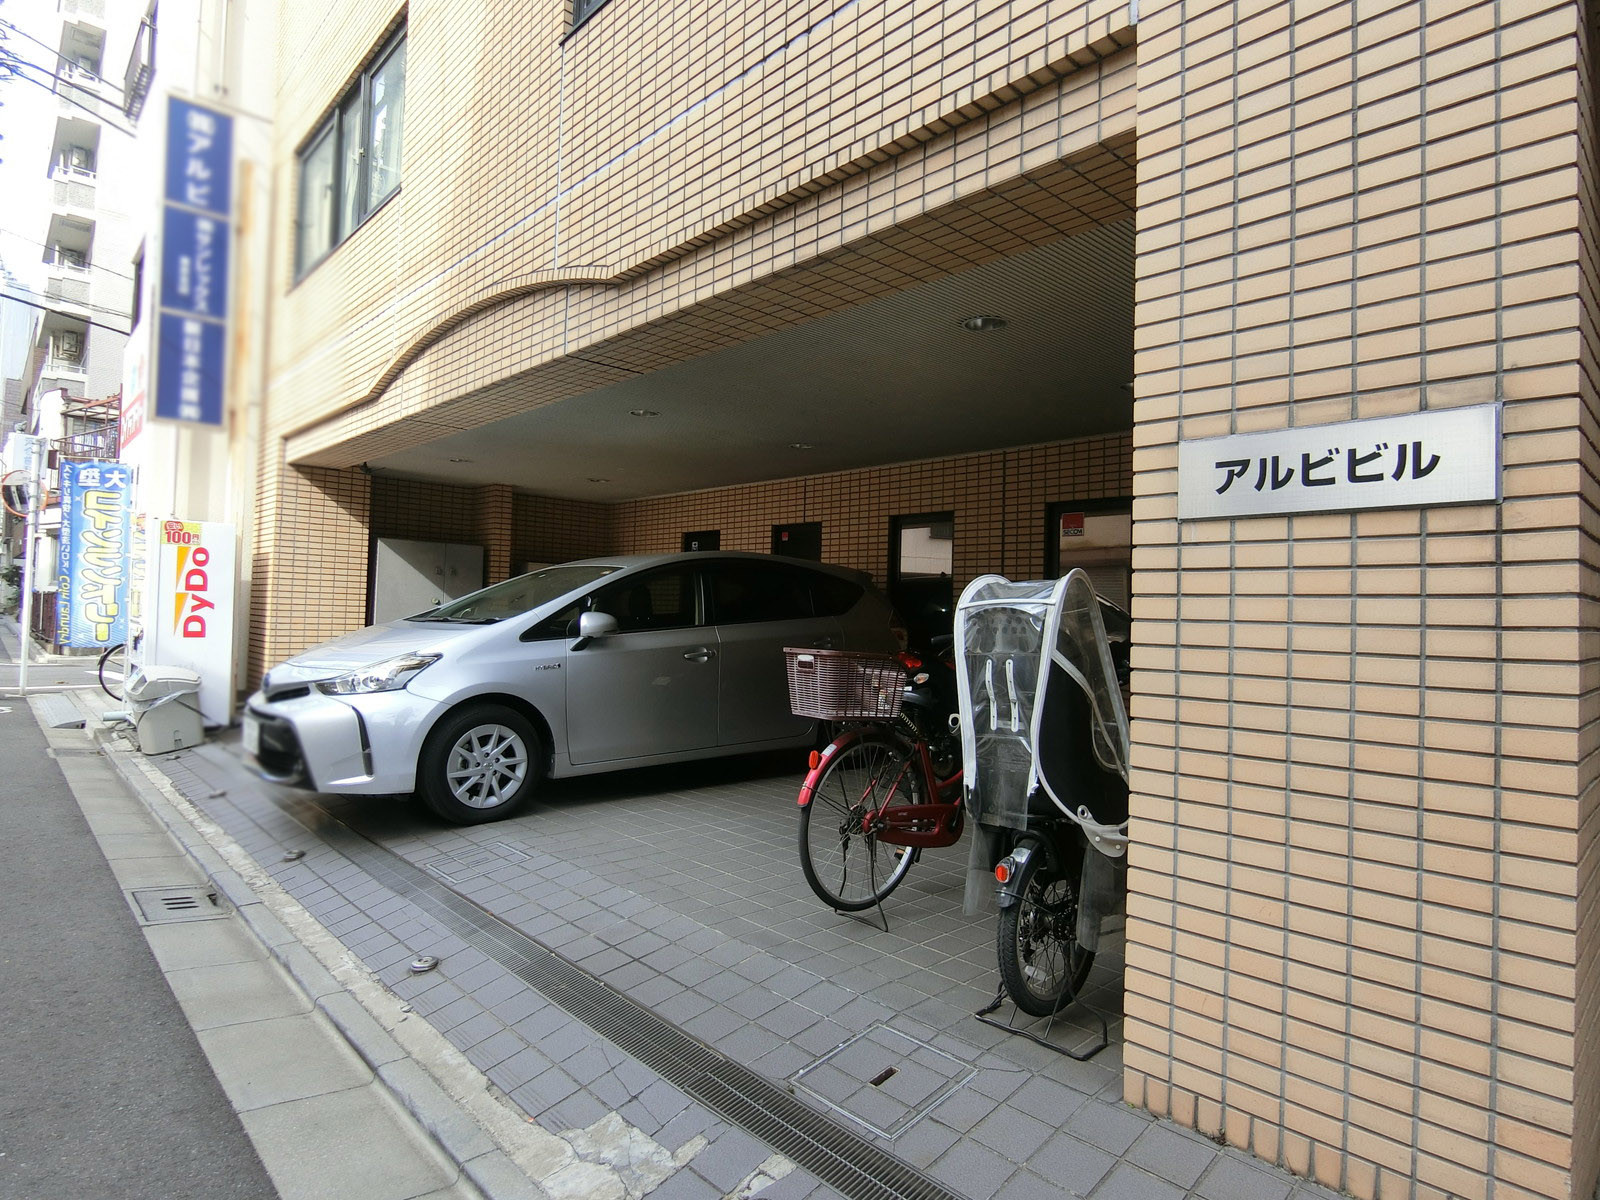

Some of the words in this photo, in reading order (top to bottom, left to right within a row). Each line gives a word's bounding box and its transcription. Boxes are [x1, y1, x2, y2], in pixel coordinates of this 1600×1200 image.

[1214, 441, 1441, 495] アルビビル
[183, 547, 215, 638] DyDo
